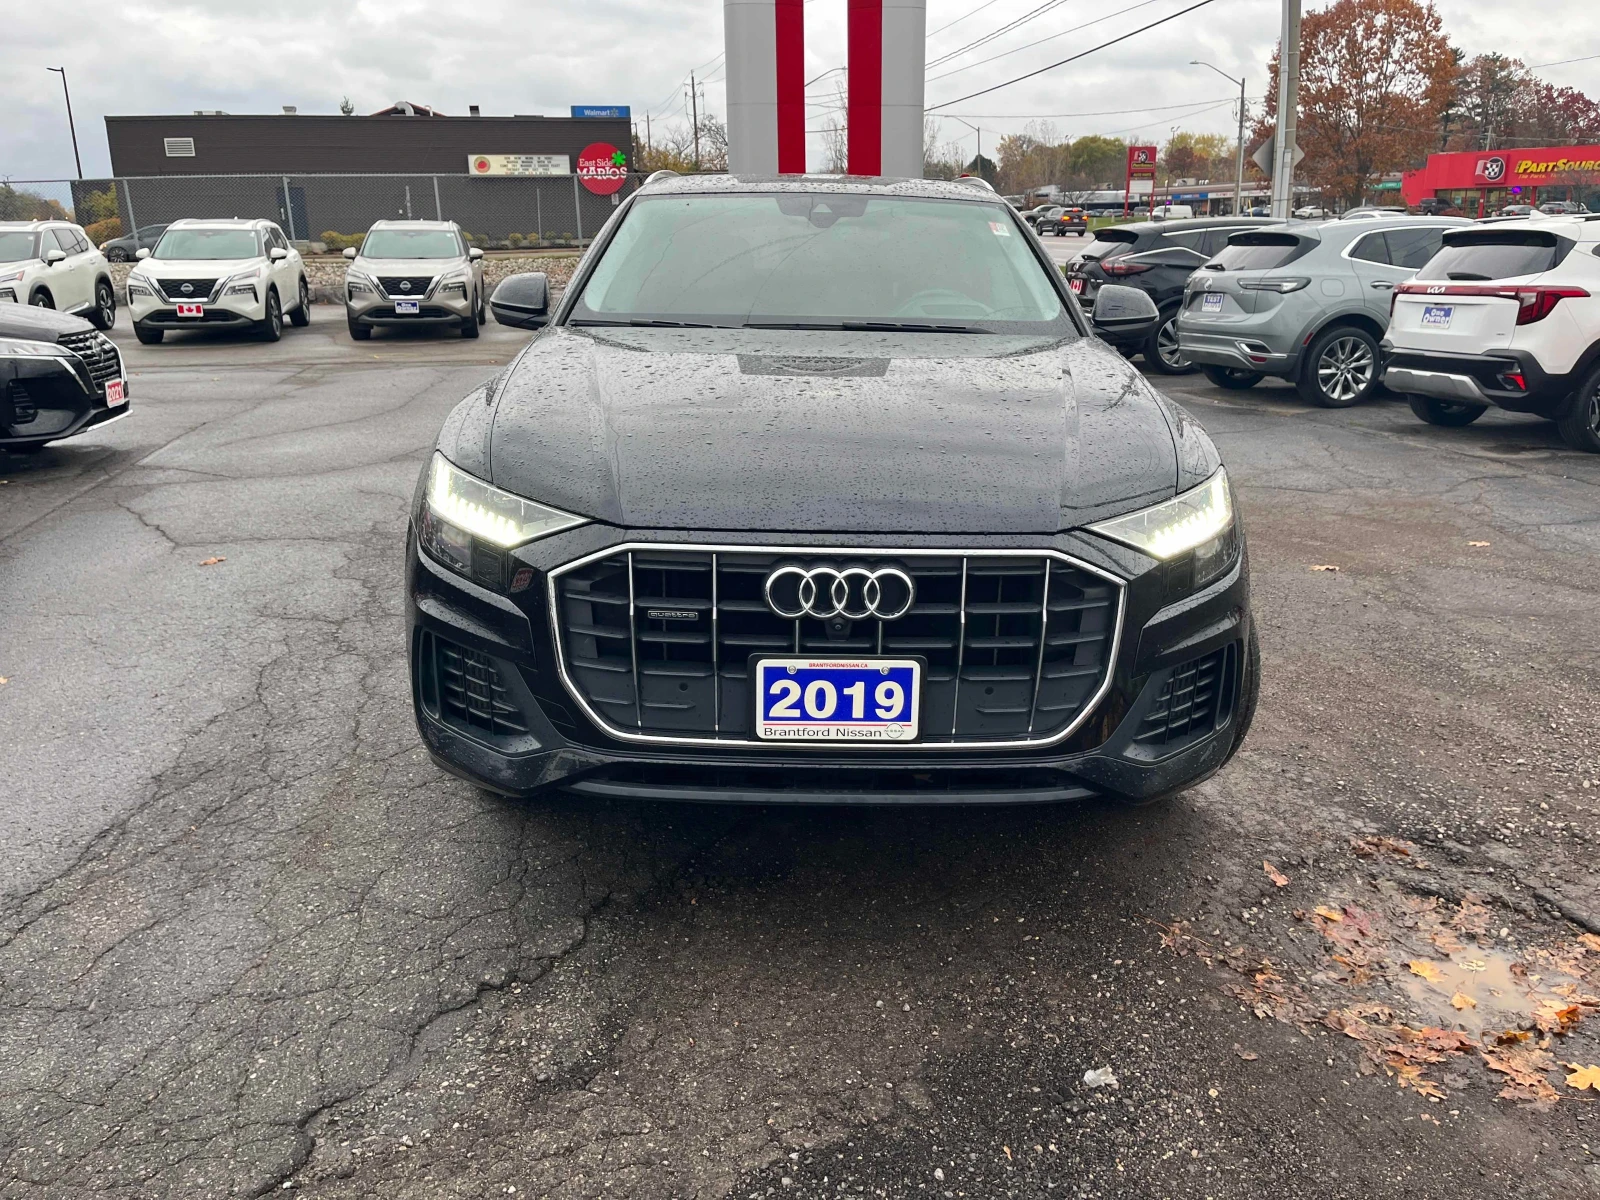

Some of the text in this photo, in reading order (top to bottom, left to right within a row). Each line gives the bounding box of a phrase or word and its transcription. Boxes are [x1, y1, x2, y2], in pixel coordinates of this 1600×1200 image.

[580, 158, 613, 167] East Side
[1423, 313, 1450, 325] Owner
[107, 384, 123, 401] 2021
[768, 679, 905, 719] 2019
[764, 727, 882, 737] Brantford Nissan
